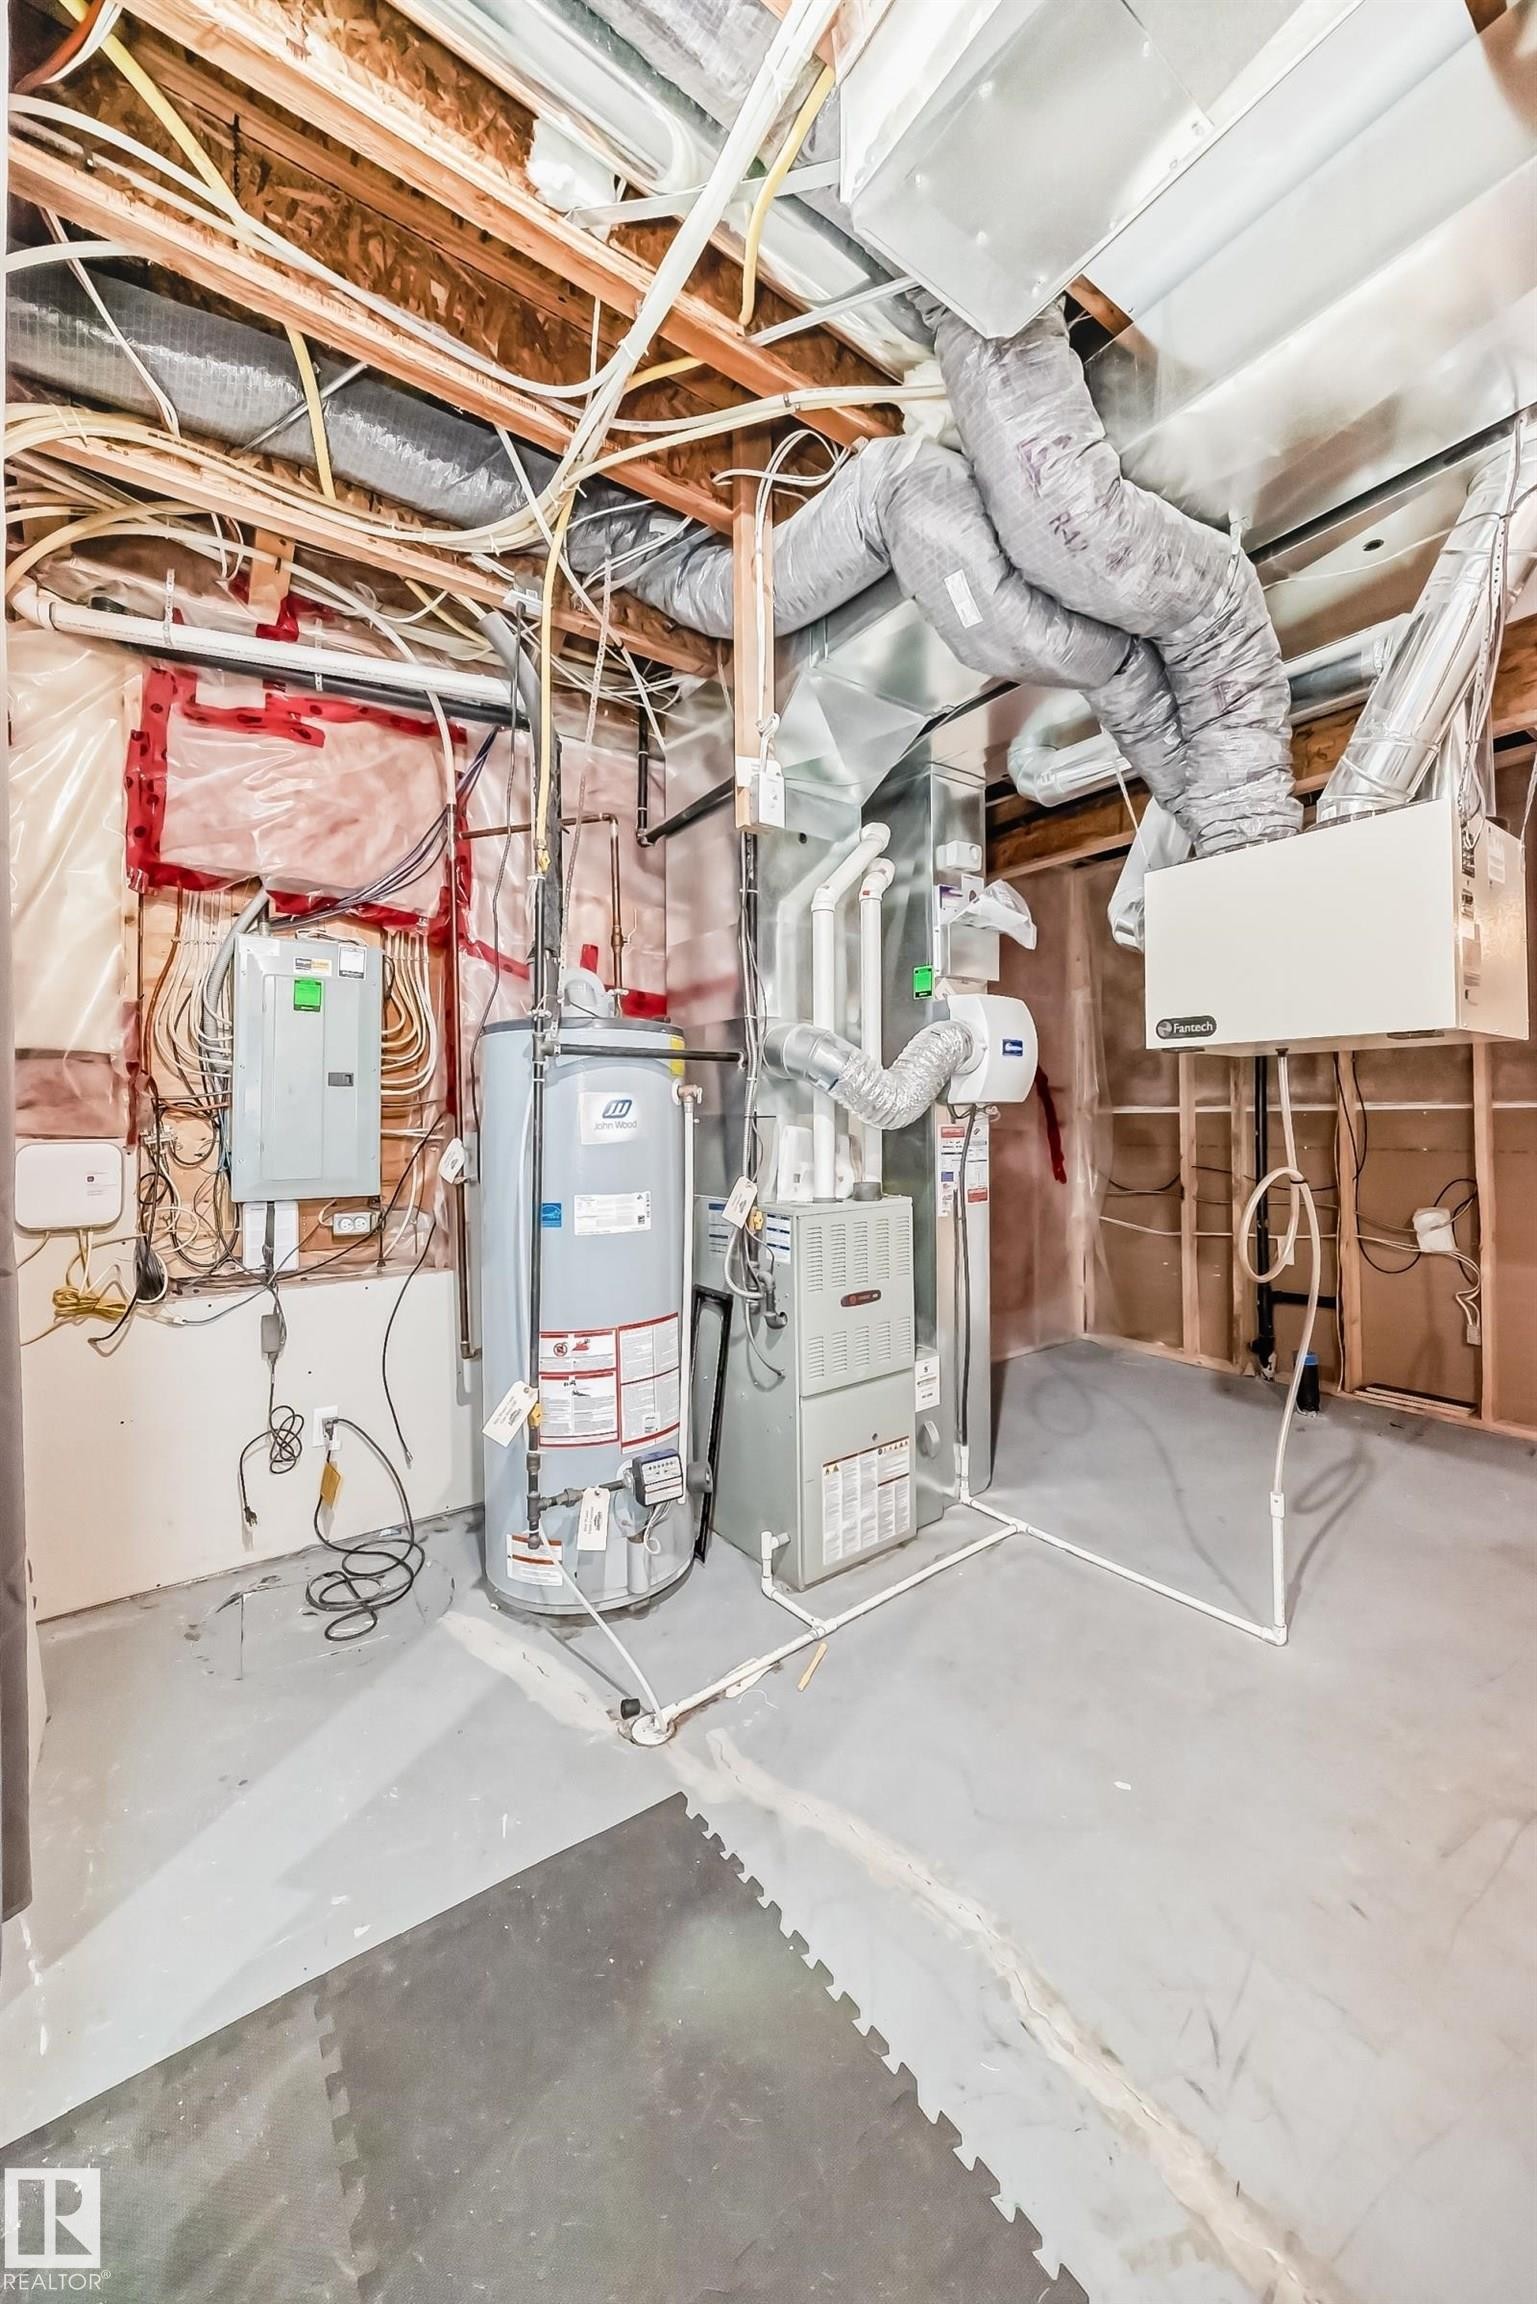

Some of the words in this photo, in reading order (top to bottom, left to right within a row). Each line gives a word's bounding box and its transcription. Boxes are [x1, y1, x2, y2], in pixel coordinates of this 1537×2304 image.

[1173, 1021, 1213, 1034] Fantech
[593, 1121, 613, 1131] John
[614, 1120, 638, 1129] Wood
